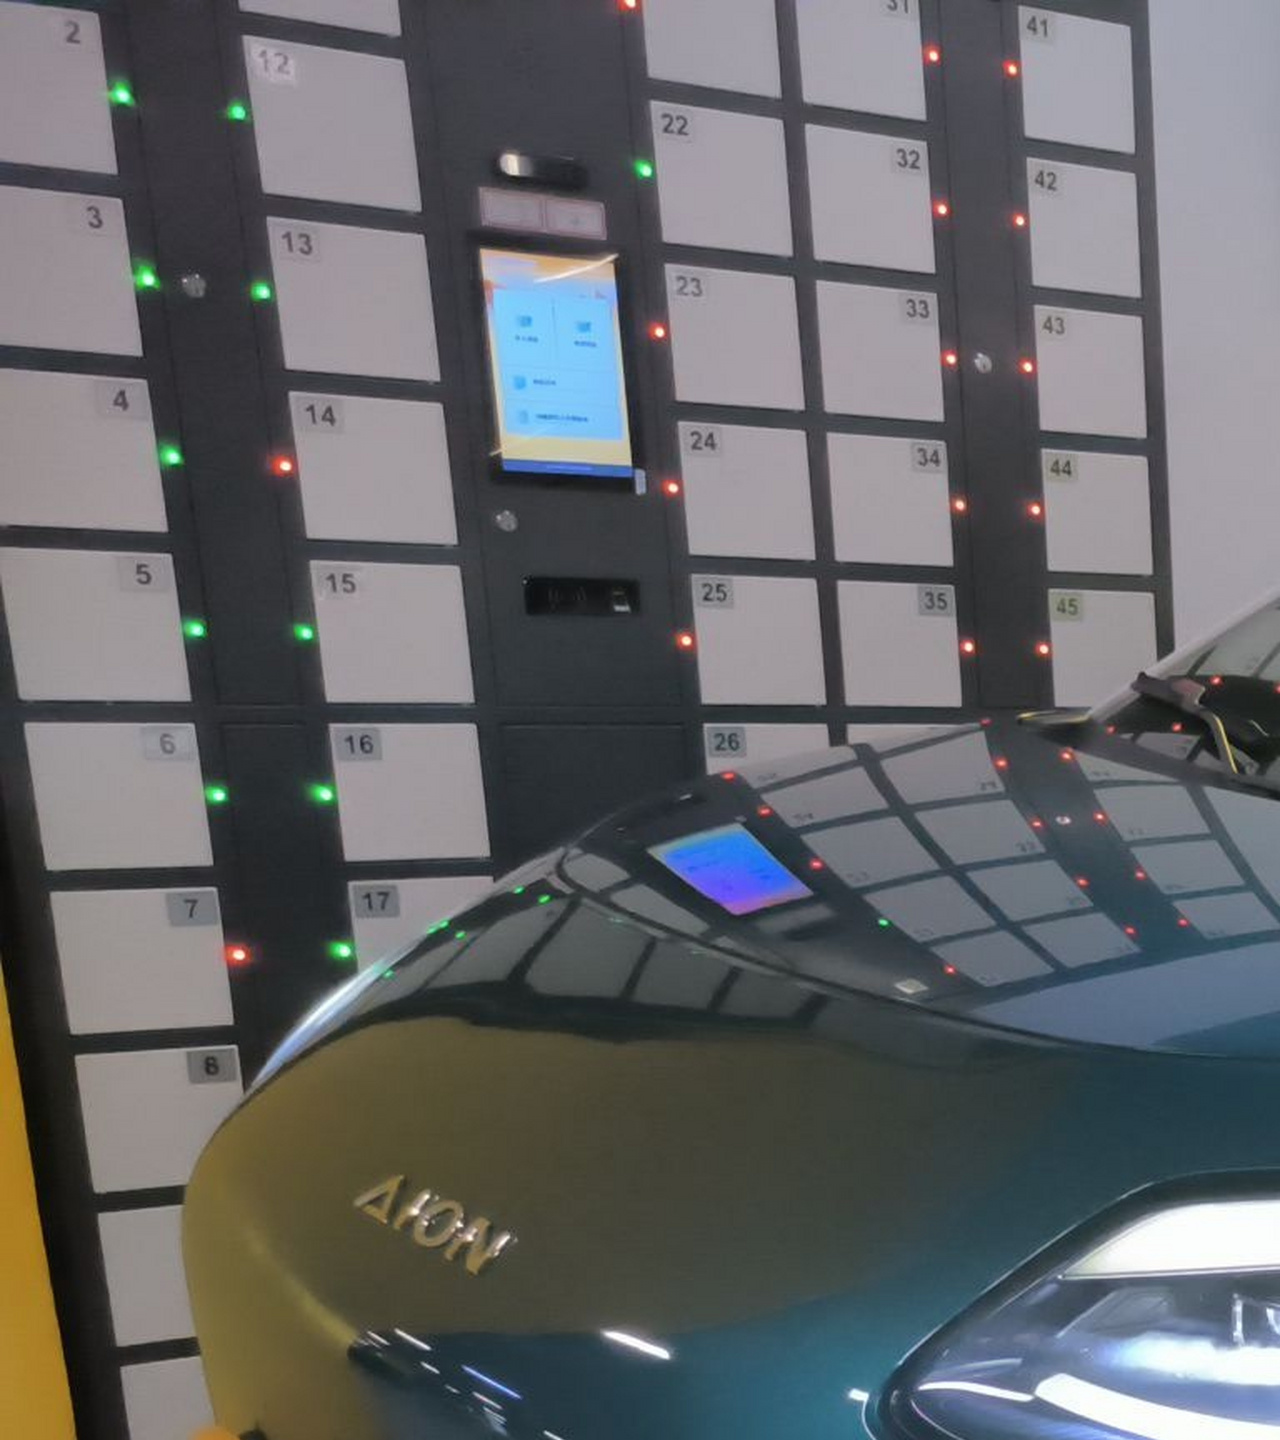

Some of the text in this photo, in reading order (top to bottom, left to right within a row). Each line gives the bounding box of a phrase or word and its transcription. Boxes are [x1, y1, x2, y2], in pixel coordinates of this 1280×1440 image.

[65, 20, 81, 45] 2
[1026, 15, 1048, 38] 41
[257, 47, 291, 76] 12
[660, 112, 689, 137] 22
[896, 148, 921, 170] 32
[1034, 169, 1057, 192] 42
[86, 205, 104, 229] 3
[281, 230, 313, 256] 13
[675, 274, 703, 298] 23
[906, 298, 930, 319] 33
[1042, 315, 1065, 336] 43
[112, 389, 130, 411] 4
[305, 403, 336, 427] 14
[689, 430, 717, 451] 24
[916, 448, 942, 468] 34
[1049, 458, 1073, 477] 44
[135, 563, 153, 586] 5
[325, 572, 357, 594] 15
[701, 582, 728, 603] 25
[924, 590, 948, 611] 35
[1056, 597, 1079, 616] 45
[159, 732, 176, 755] 6
[344, 734, 374, 755] 16
[713, 732, 741, 752] 26
[183, 898, 199, 919] 7
[362, 890, 391, 911] 17
[203, 1055, 220, 1076] 8
[353, 1174, 516, 1276] AION
